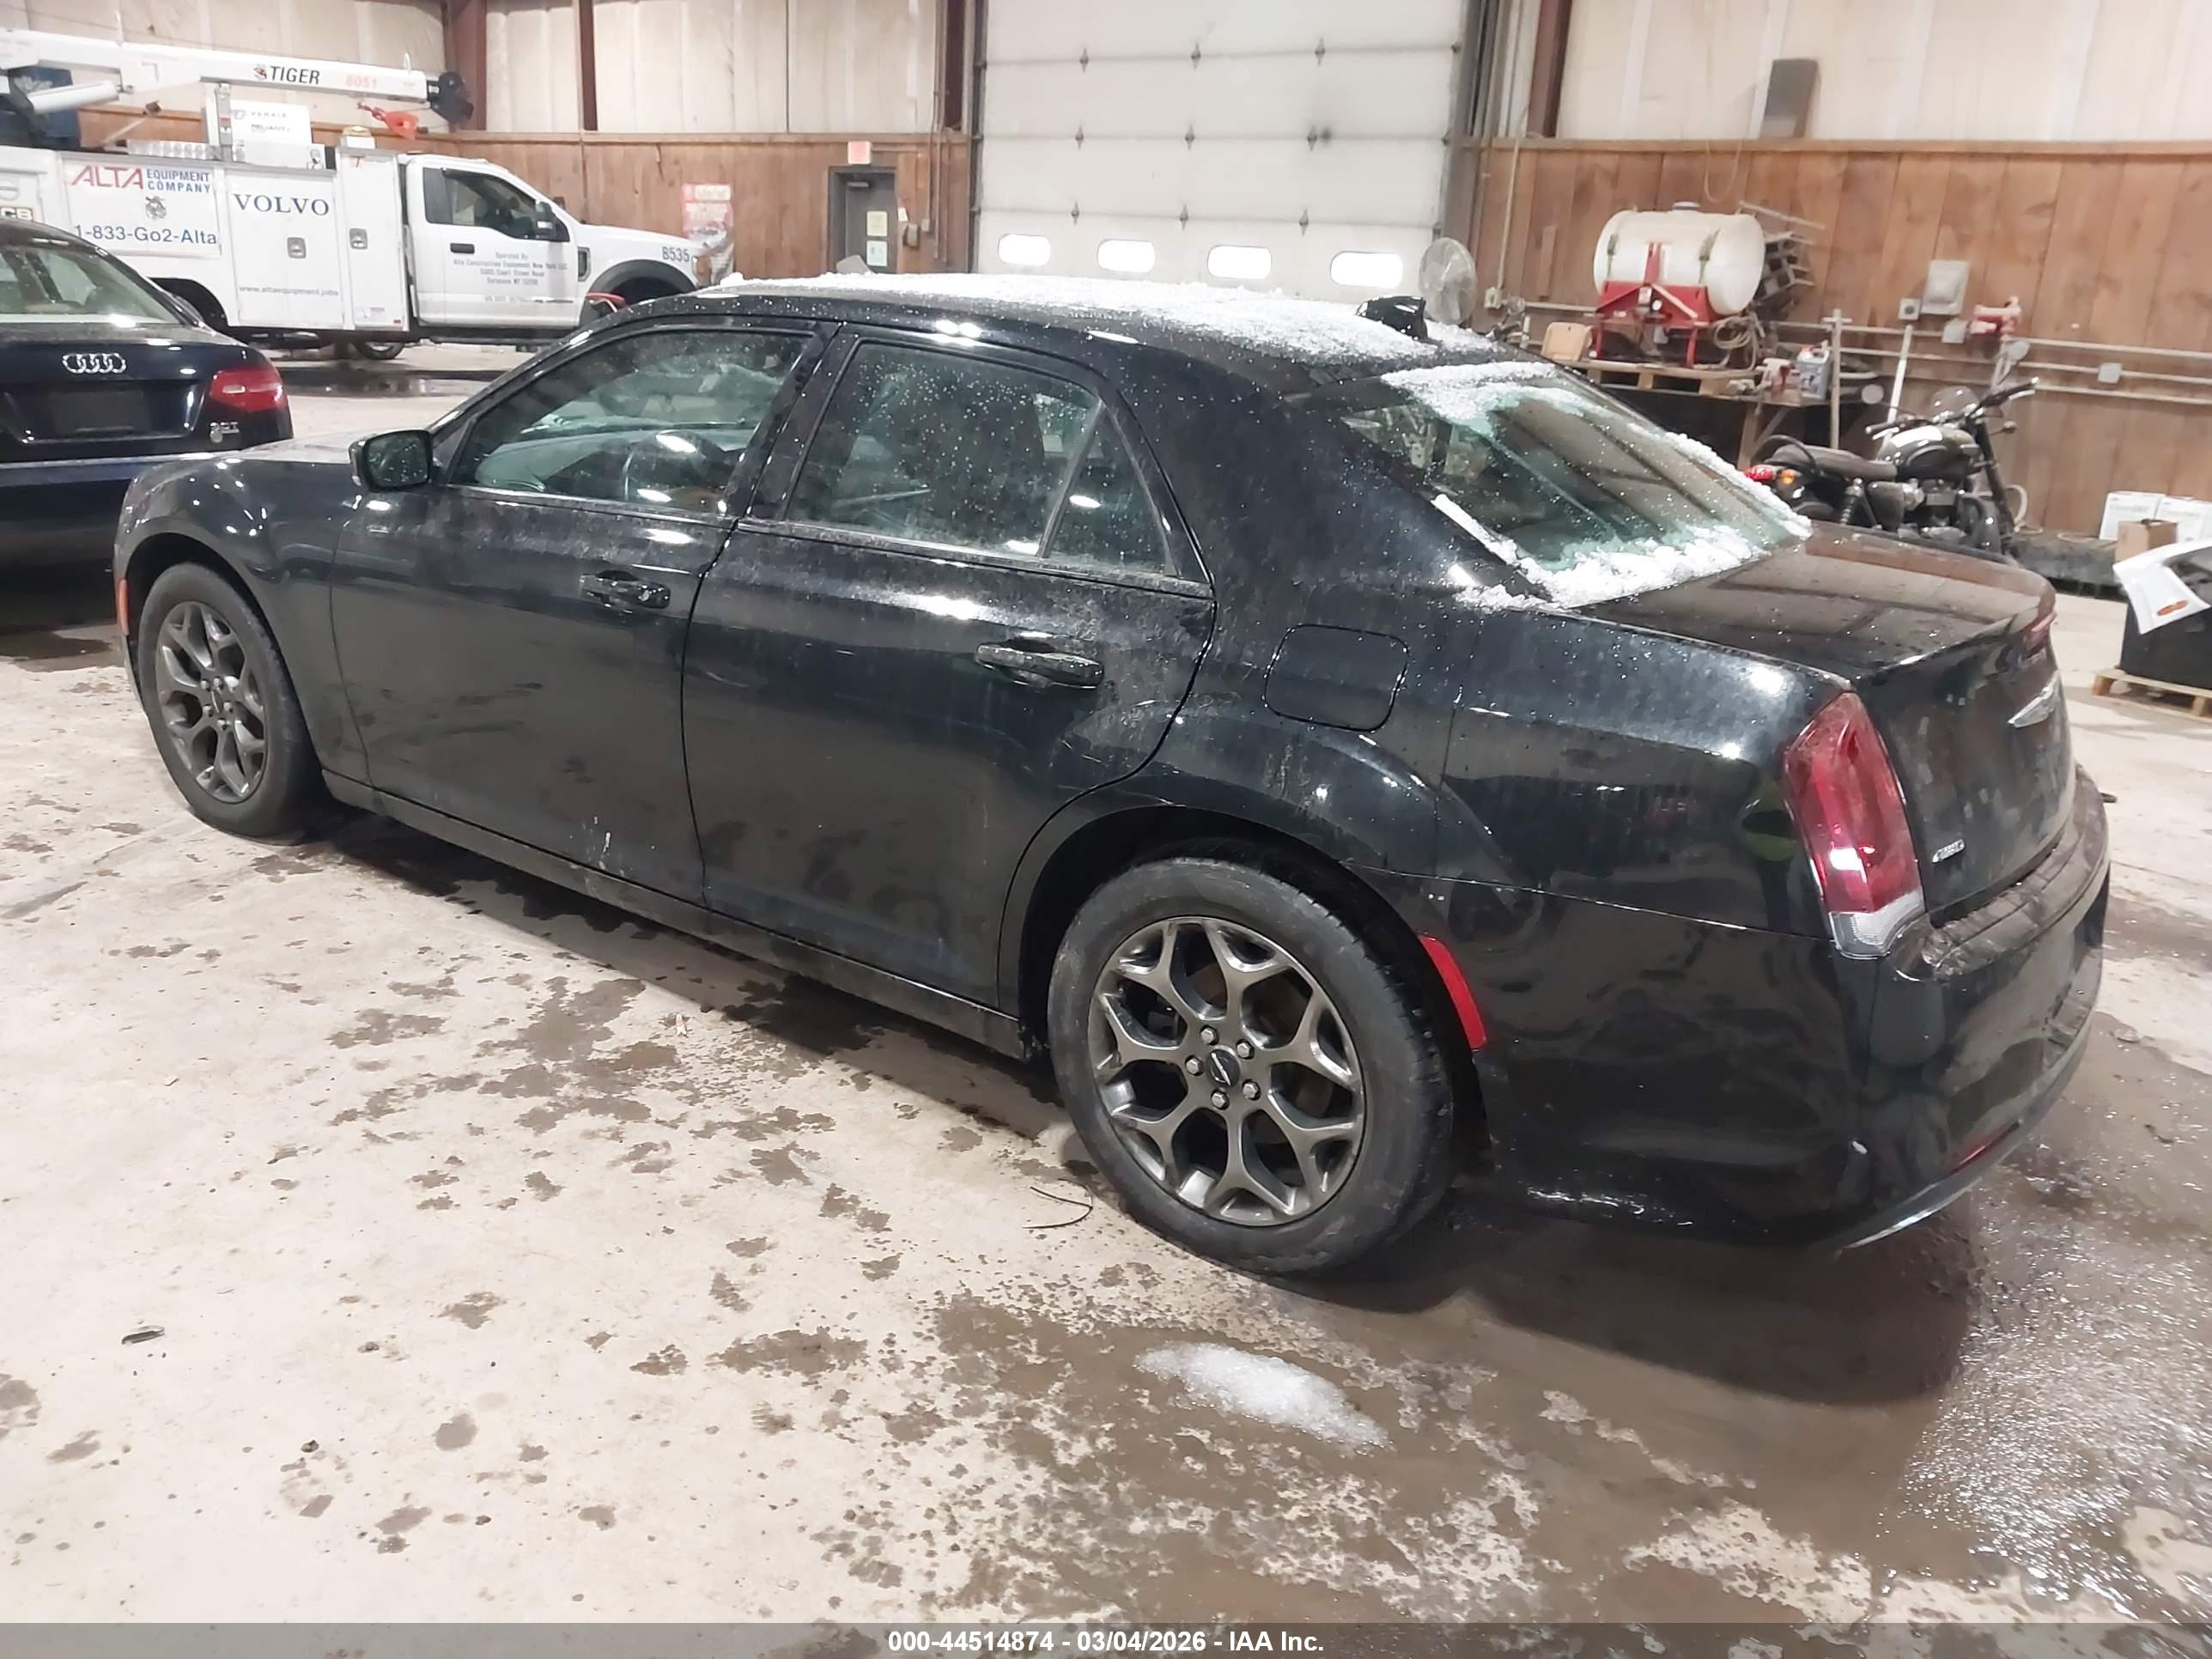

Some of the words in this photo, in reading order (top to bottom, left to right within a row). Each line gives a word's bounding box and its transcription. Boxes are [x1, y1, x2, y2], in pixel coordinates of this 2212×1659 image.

[270, 65, 320, 85] TIGER
[71, 165, 143, 189] ALTA
[147, 168, 210, 183] EQUIPMENT
[148, 180, 211, 193] COMPANY
[0, 207, 32, 221] CB
[233, 193, 330, 216] VOLVO
[75, 224, 217, 244] 1-833-Go2-Alta
